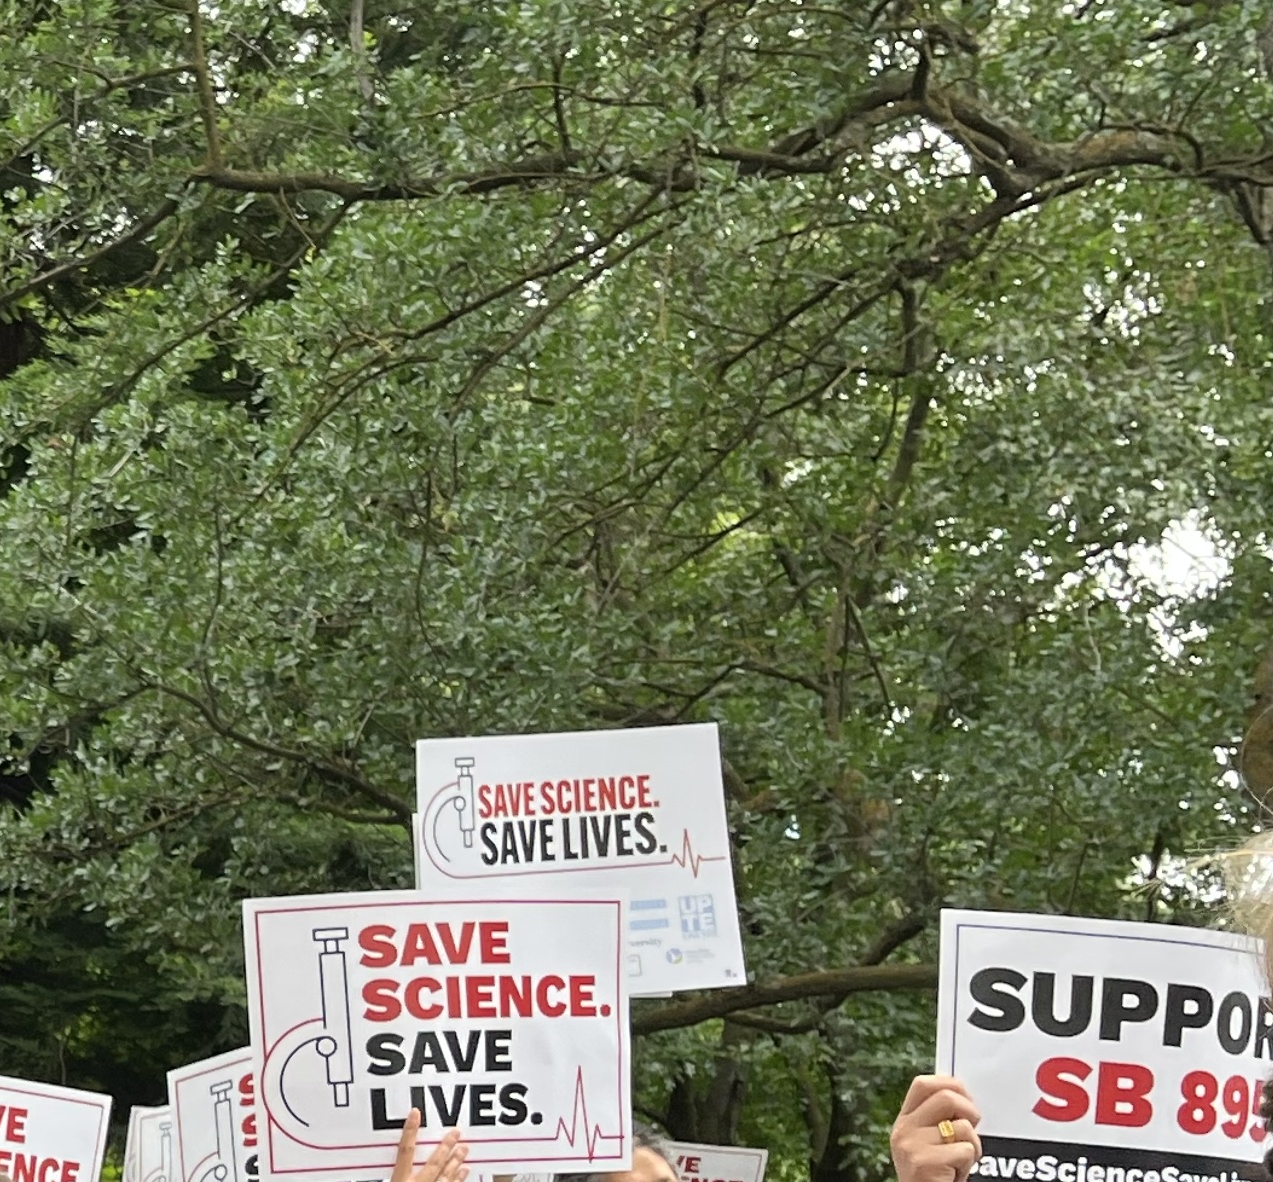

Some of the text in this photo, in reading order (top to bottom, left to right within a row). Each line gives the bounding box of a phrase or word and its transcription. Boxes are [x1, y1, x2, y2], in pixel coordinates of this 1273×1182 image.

[479, 775, 660, 819] SAVE SCIENCE.
[481, 812, 668, 866] SAVE LIVES.
[357, 921, 511, 967] SAVE
[362, 975, 611, 1022] SCIENCE.
[367, 1030, 512, 1076] SAVE
[370, 1084, 543, 1131] LIVES.
[1032, 1057, 1154, 1128] SB
